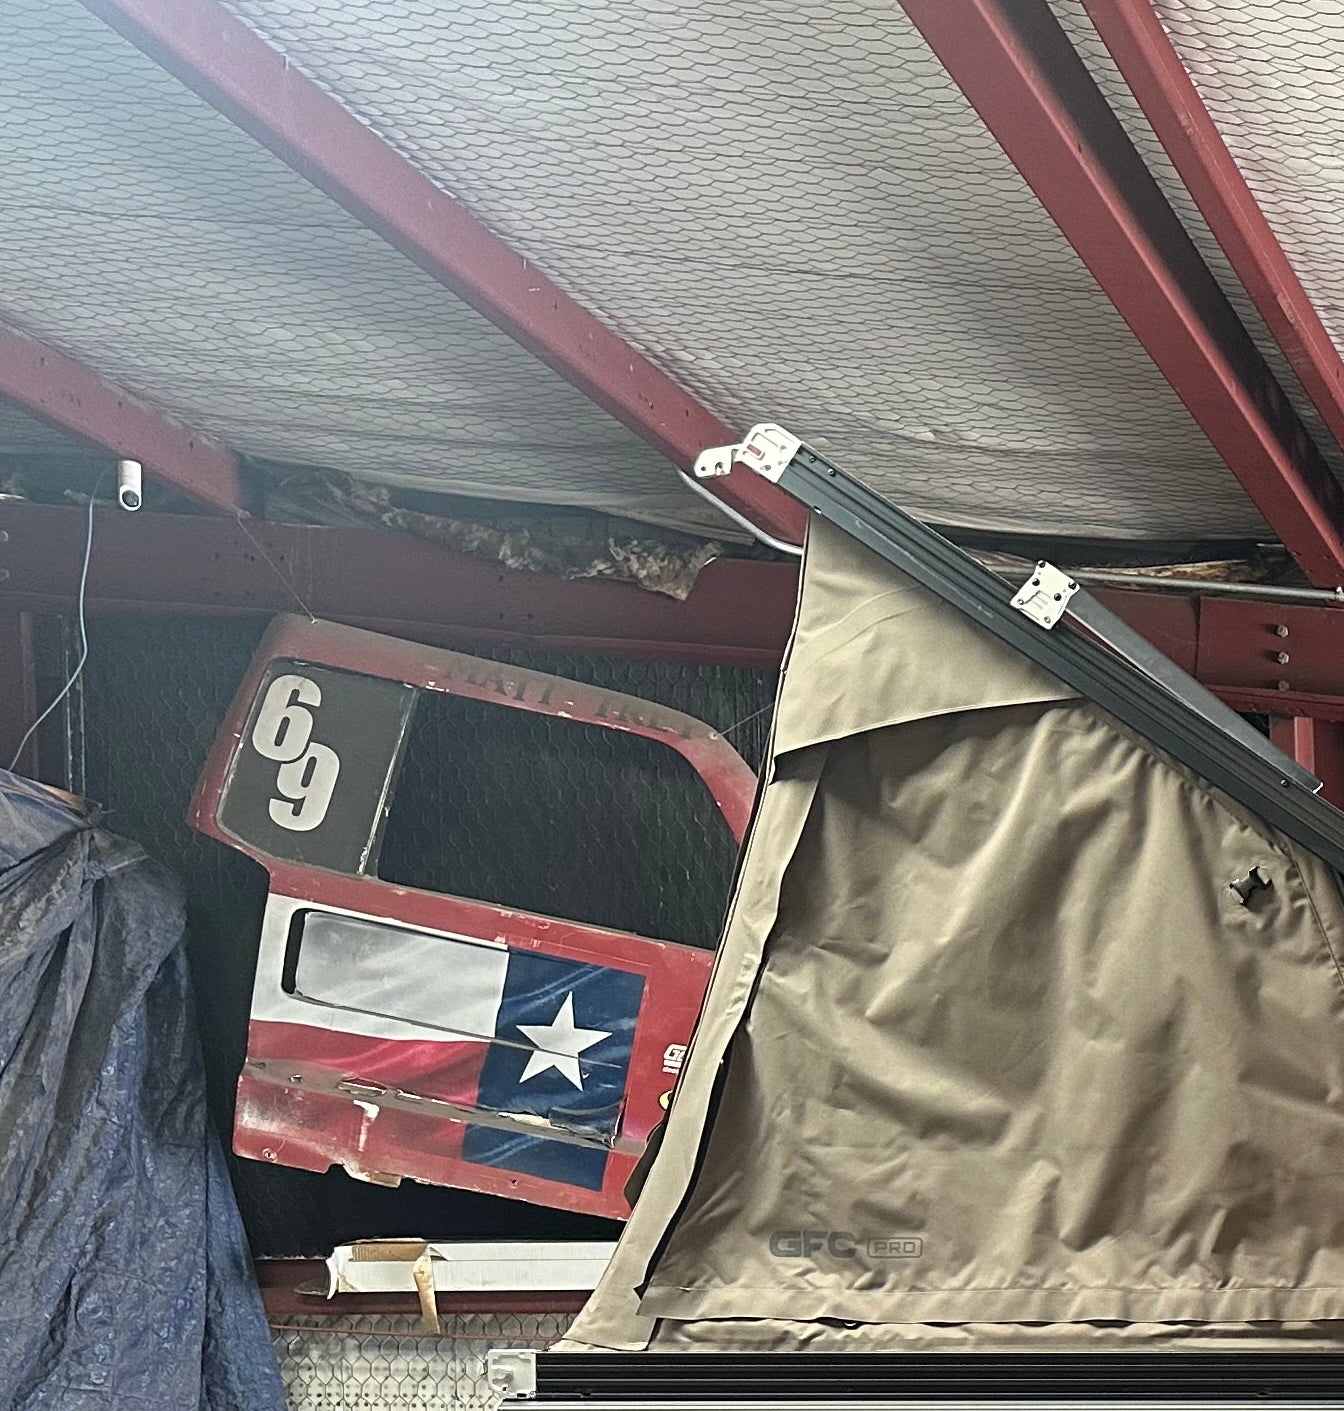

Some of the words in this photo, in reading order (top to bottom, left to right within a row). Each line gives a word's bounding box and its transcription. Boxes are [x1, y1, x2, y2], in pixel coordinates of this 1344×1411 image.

[252, 674, 340, 832] 69
[769, 1231, 857, 1258] GFC
[874, 1242, 916, 1254] PRO
